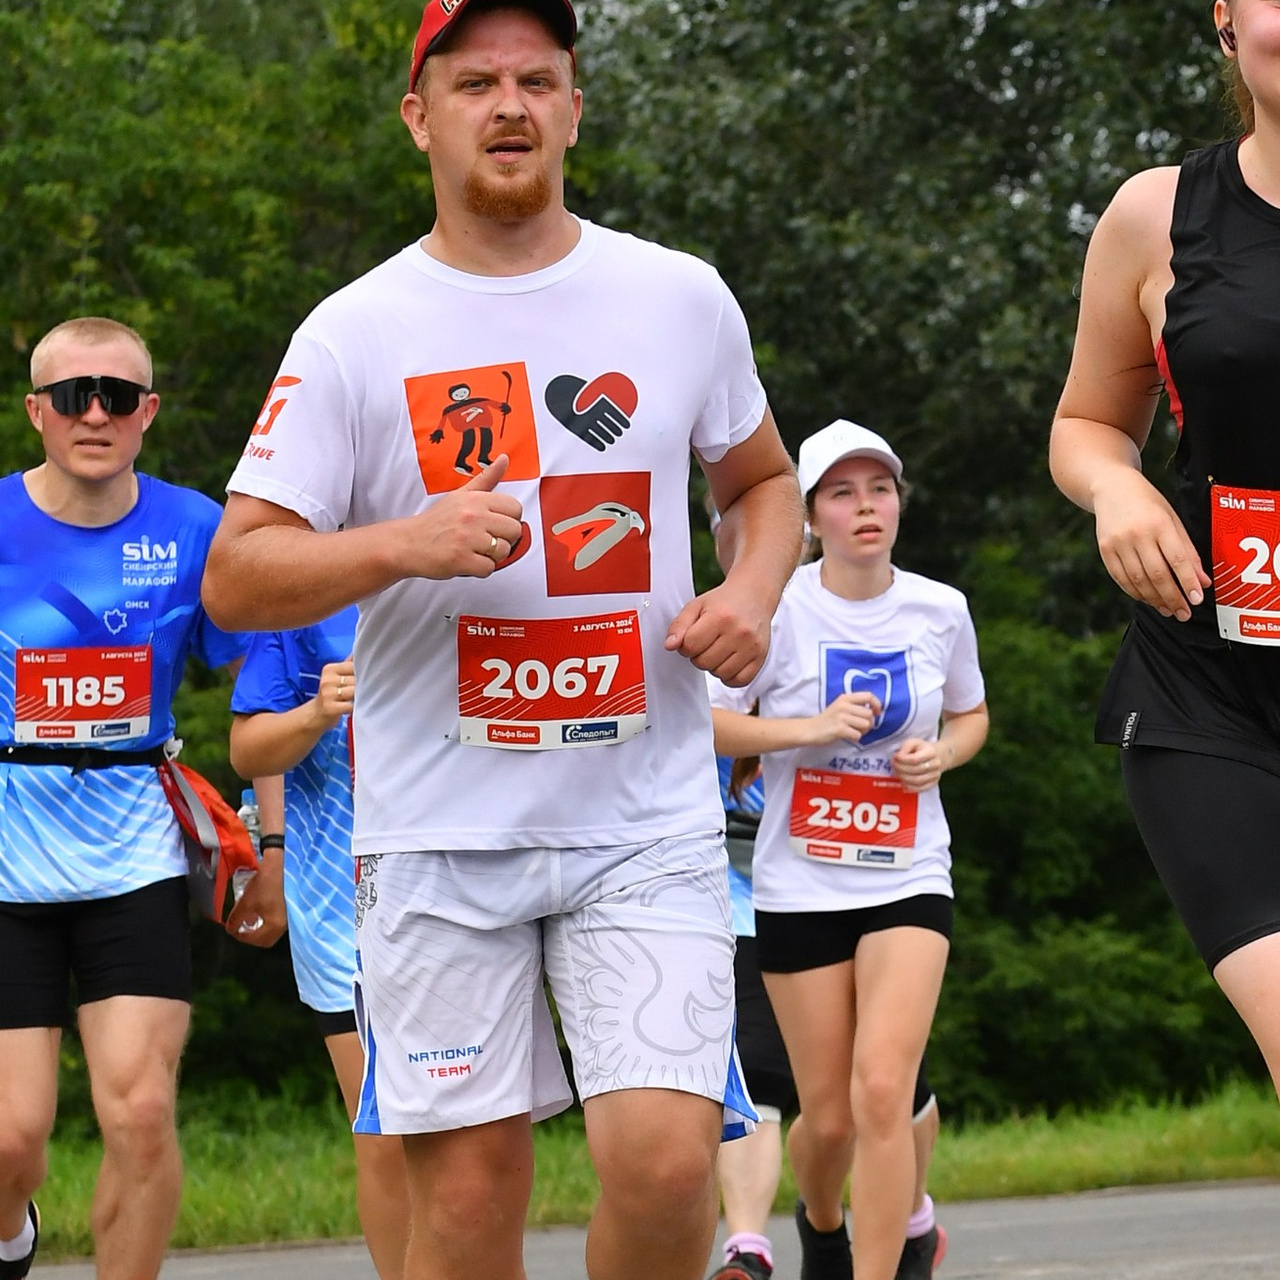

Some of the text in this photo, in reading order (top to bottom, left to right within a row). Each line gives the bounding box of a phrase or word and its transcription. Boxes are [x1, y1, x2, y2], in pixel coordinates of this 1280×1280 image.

[123, 575, 177, 586] МАРАФОН
[125, 600, 150, 609] ОМСК
[580, 621, 615, 631] АВГУСТА
[481, 654, 620, 700] 2067
[42, 676, 126, 707] 1185
[571, 729, 616, 739] Следопыт
[807, 796, 901, 834] 2305
[408, 1044, 484, 1063] NATIONAL
[427, 1064, 471, 1079] TEAM
